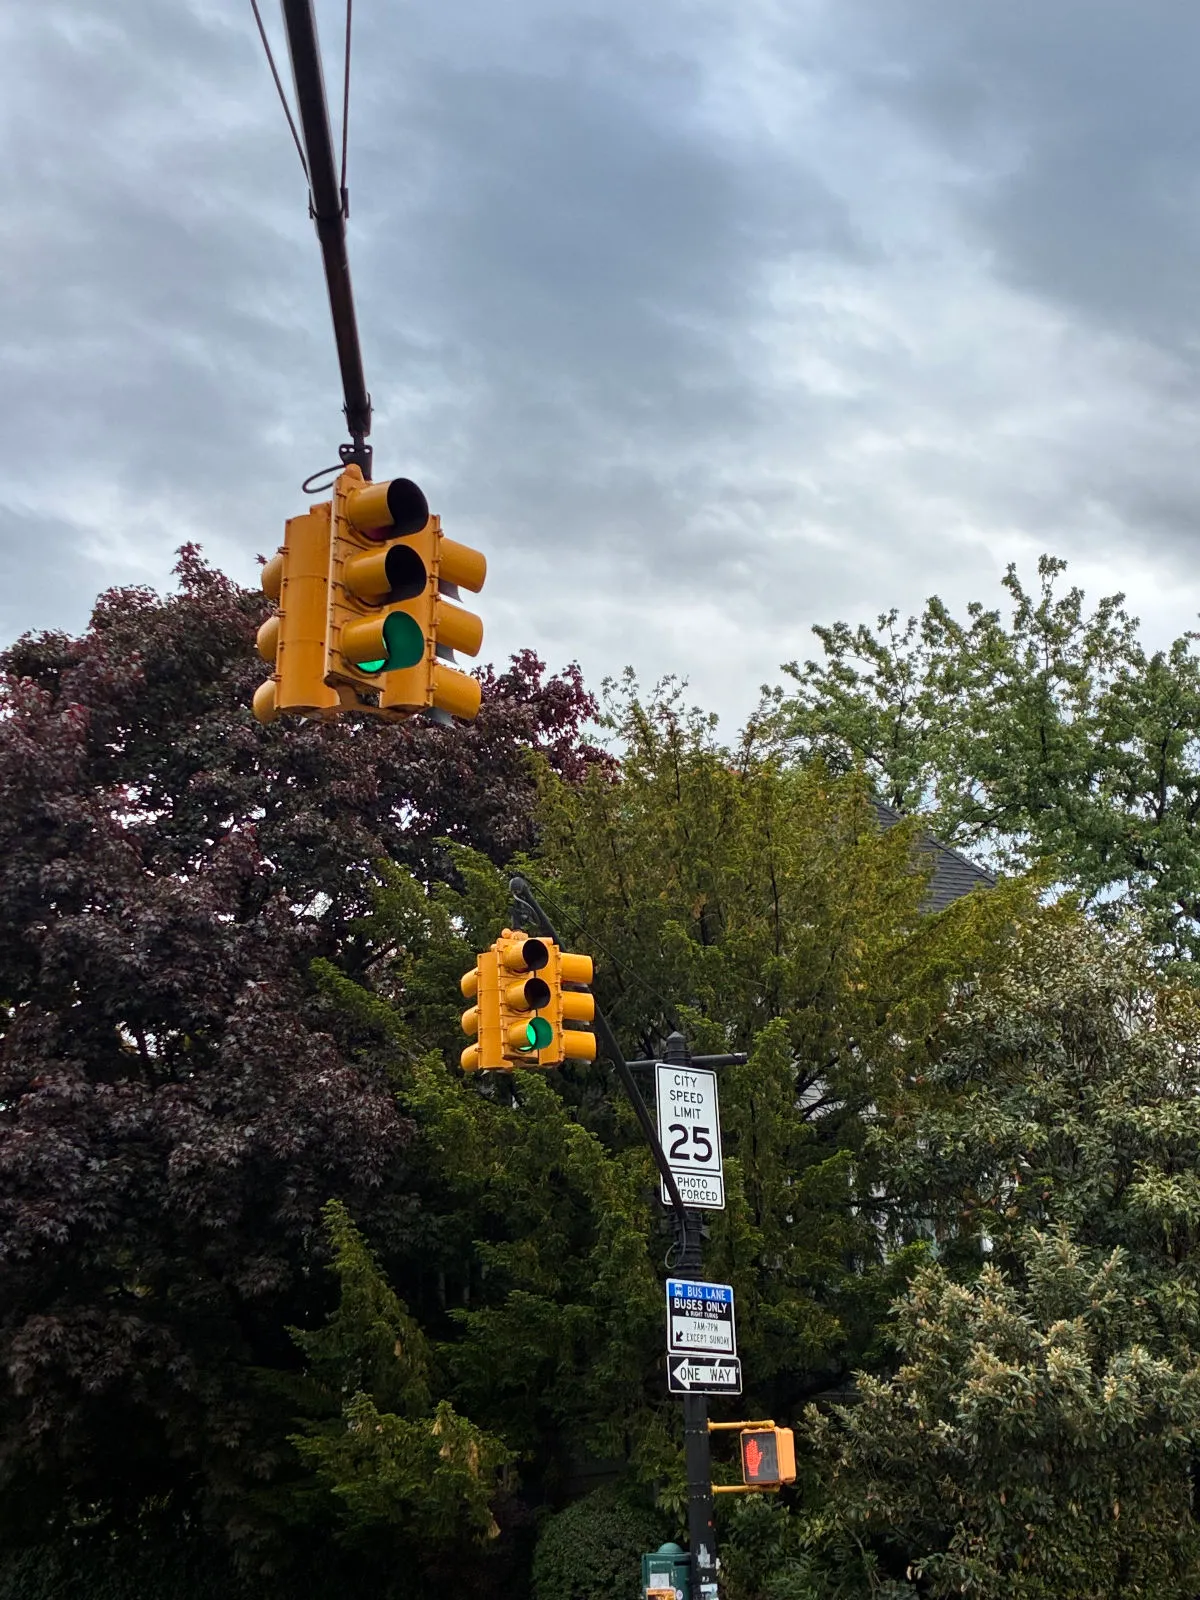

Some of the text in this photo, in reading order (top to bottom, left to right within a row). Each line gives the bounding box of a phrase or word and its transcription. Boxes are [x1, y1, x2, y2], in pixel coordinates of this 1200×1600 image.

[674, 1074, 697, 1088] CITY
[669, 1089, 704, 1104] SPEED
[674, 1106, 701, 1120] LIMIT
[668, 1123, 713, 1163] 25
[677, 1176, 708, 1189] PHOTO
[678, 1188, 718, 1202] FORCED
[687, 1286, 726, 1301] BUS LANE
[674, 1297, 728, 1314] BUSES ONLY
[693, 1321, 719, 1332] 7AM-7PM
[686, 1333, 729, 1345] EXCEPT SUNDAY
[680, 1367, 731, 1382] ONE WAY
